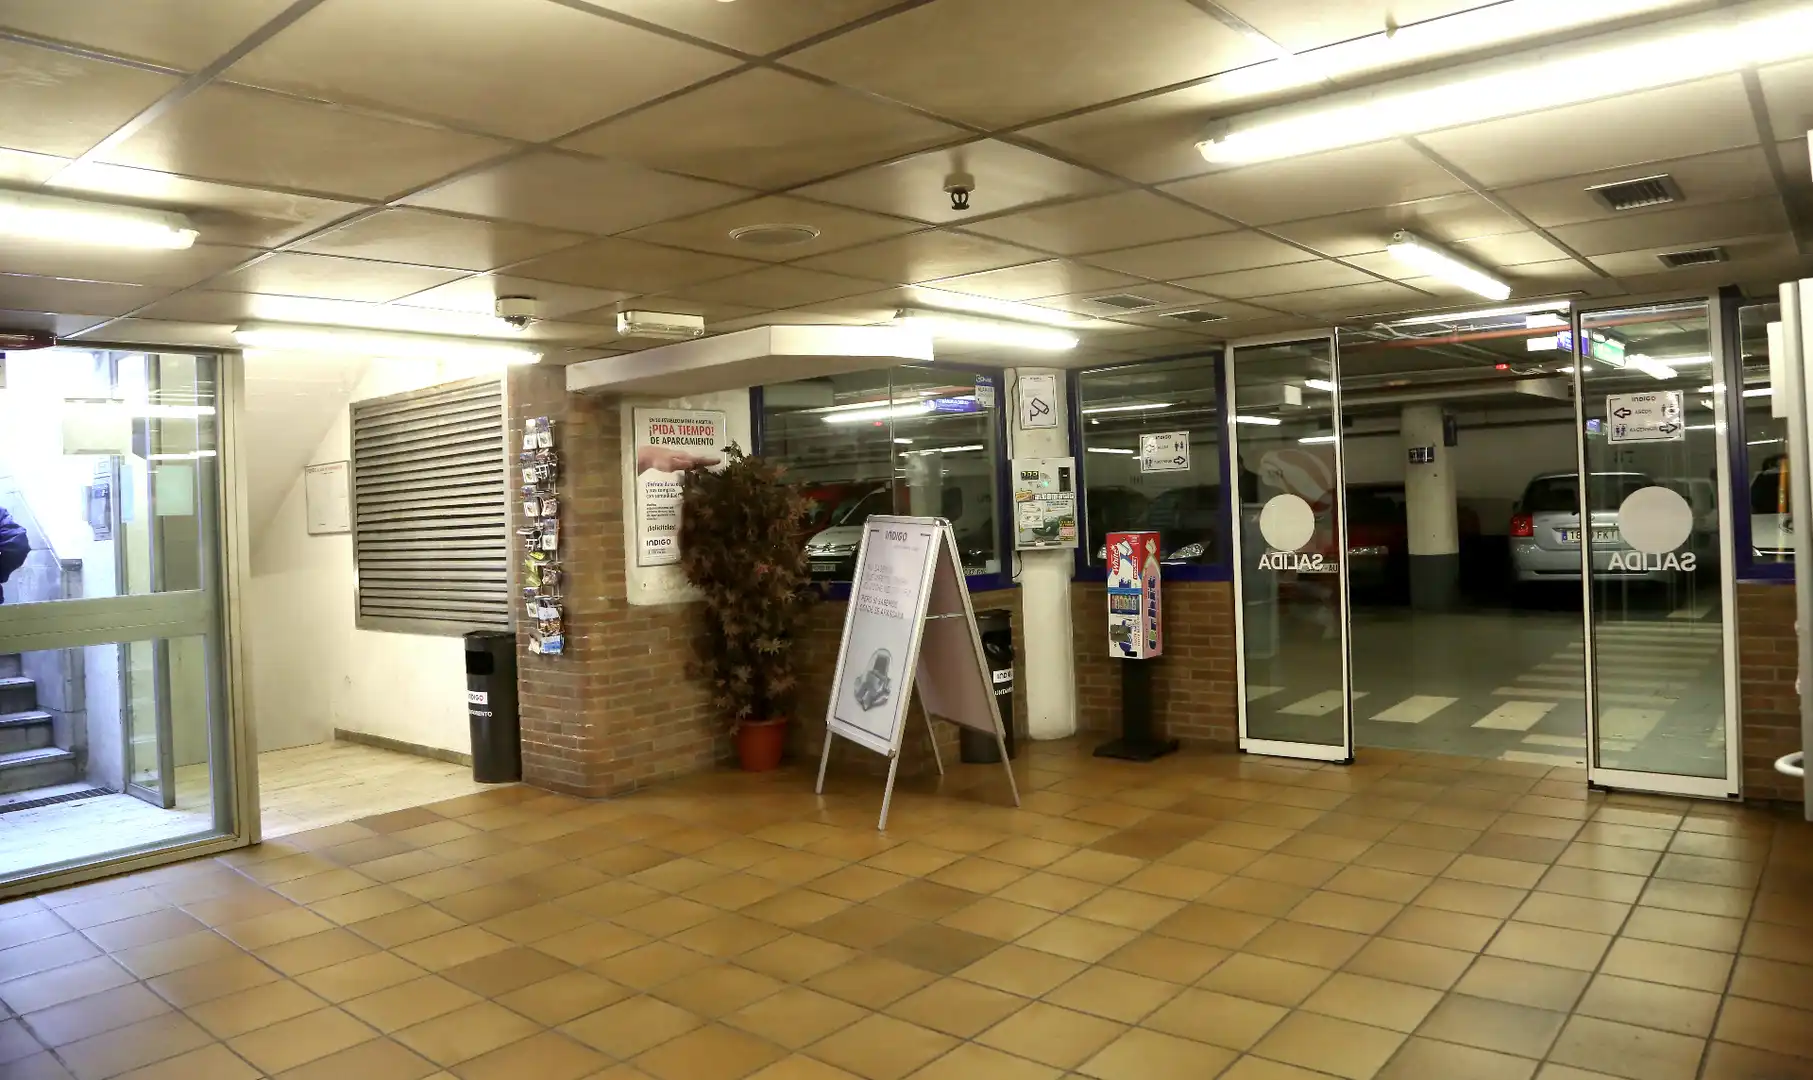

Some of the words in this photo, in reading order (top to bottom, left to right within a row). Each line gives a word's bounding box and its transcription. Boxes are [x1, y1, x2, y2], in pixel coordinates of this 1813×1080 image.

[649, 424, 675, 436] ¡PIDA
[678, 425, 714, 436] TIEMPO!
[650, 436, 660, 445] DE
[662, 436, 714, 446] APARCAMIENTO
[646, 538, 672, 546] INDIGO
[885, 530, 908, 543] INDIGO
